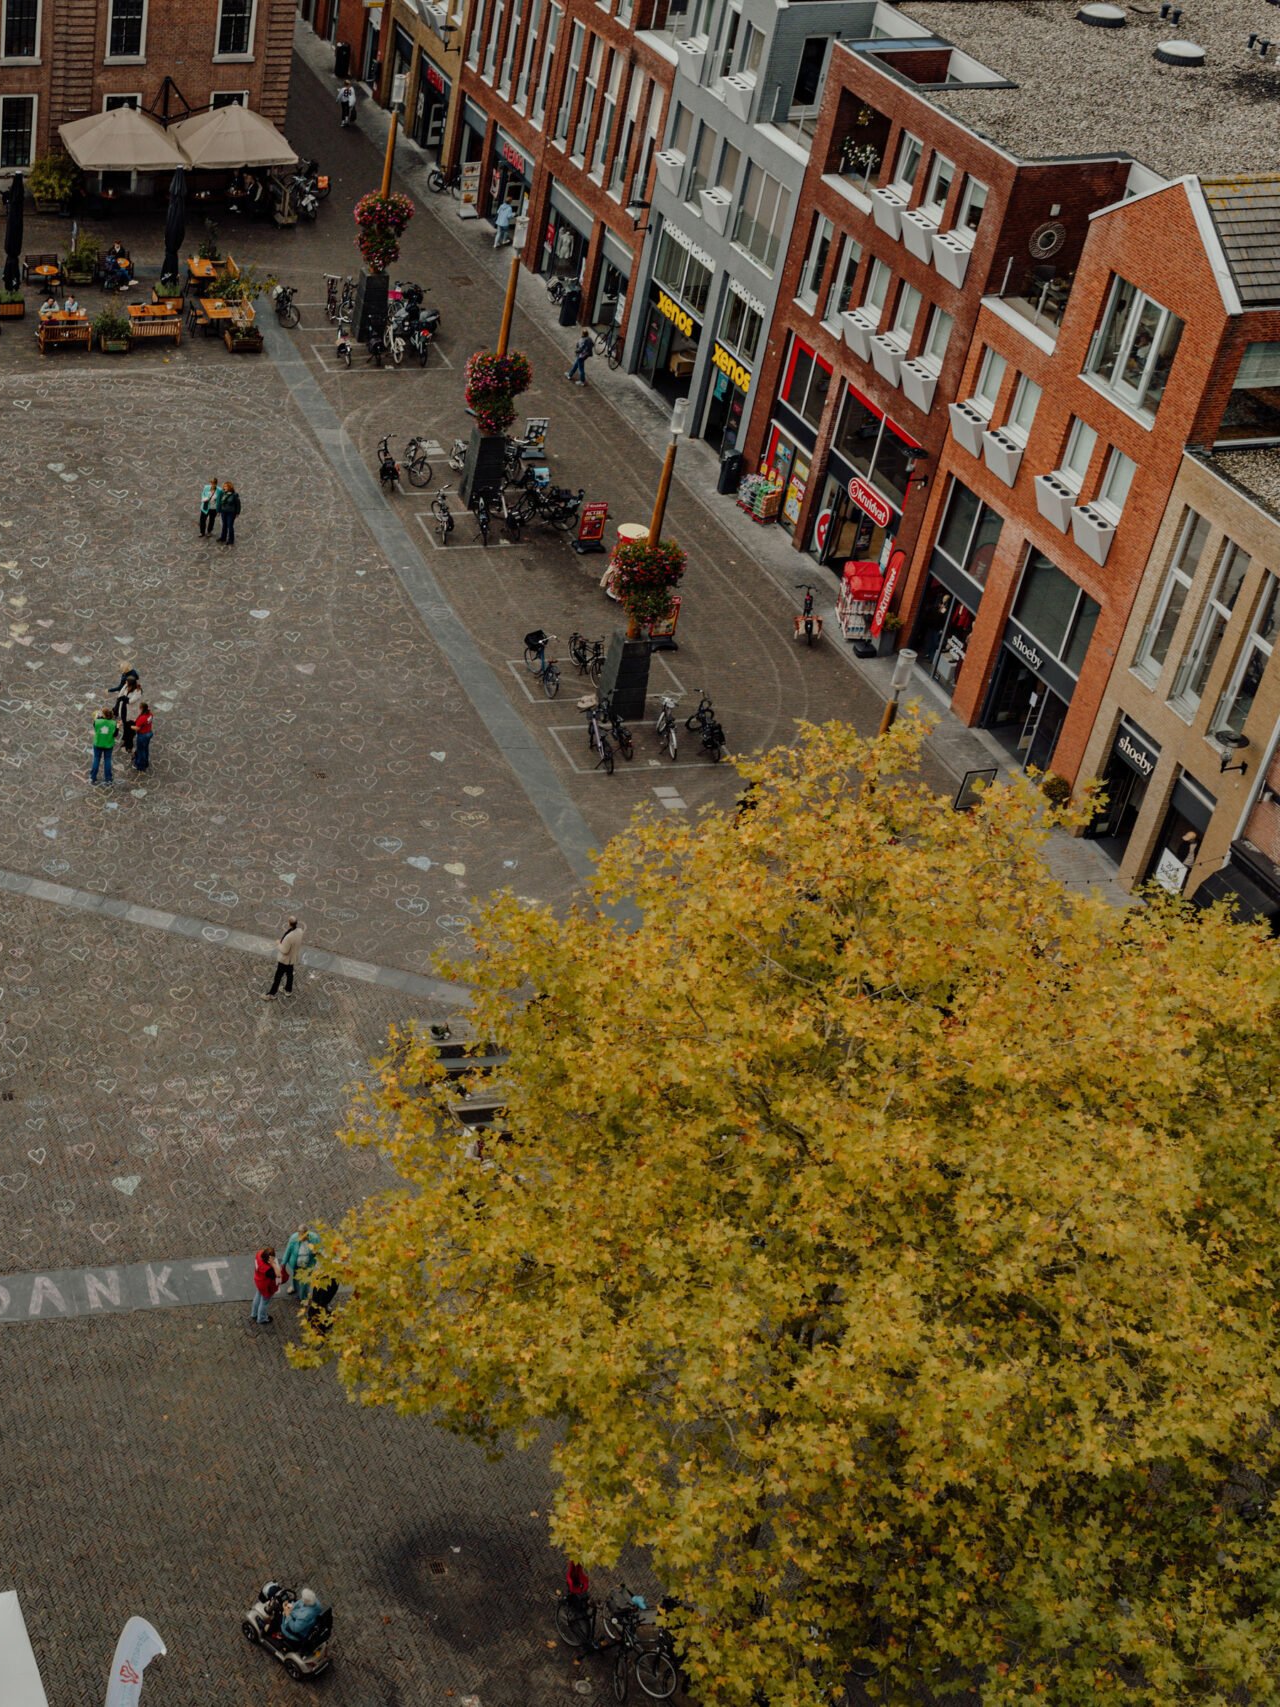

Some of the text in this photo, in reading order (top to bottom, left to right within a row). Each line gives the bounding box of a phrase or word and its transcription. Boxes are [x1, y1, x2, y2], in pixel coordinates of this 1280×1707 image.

[501, 141, 526, 175] HEMA
[656, 290, 694, 337] xenos
[711, 342, 752, 393] xenos
[856, 488, 887, 524] Kruidvat
[878, 567, 897, 613] Kruidvat
[1011, 634, 1043, 671] shoeby
[1118, 735, 1154, 776] shoeby
